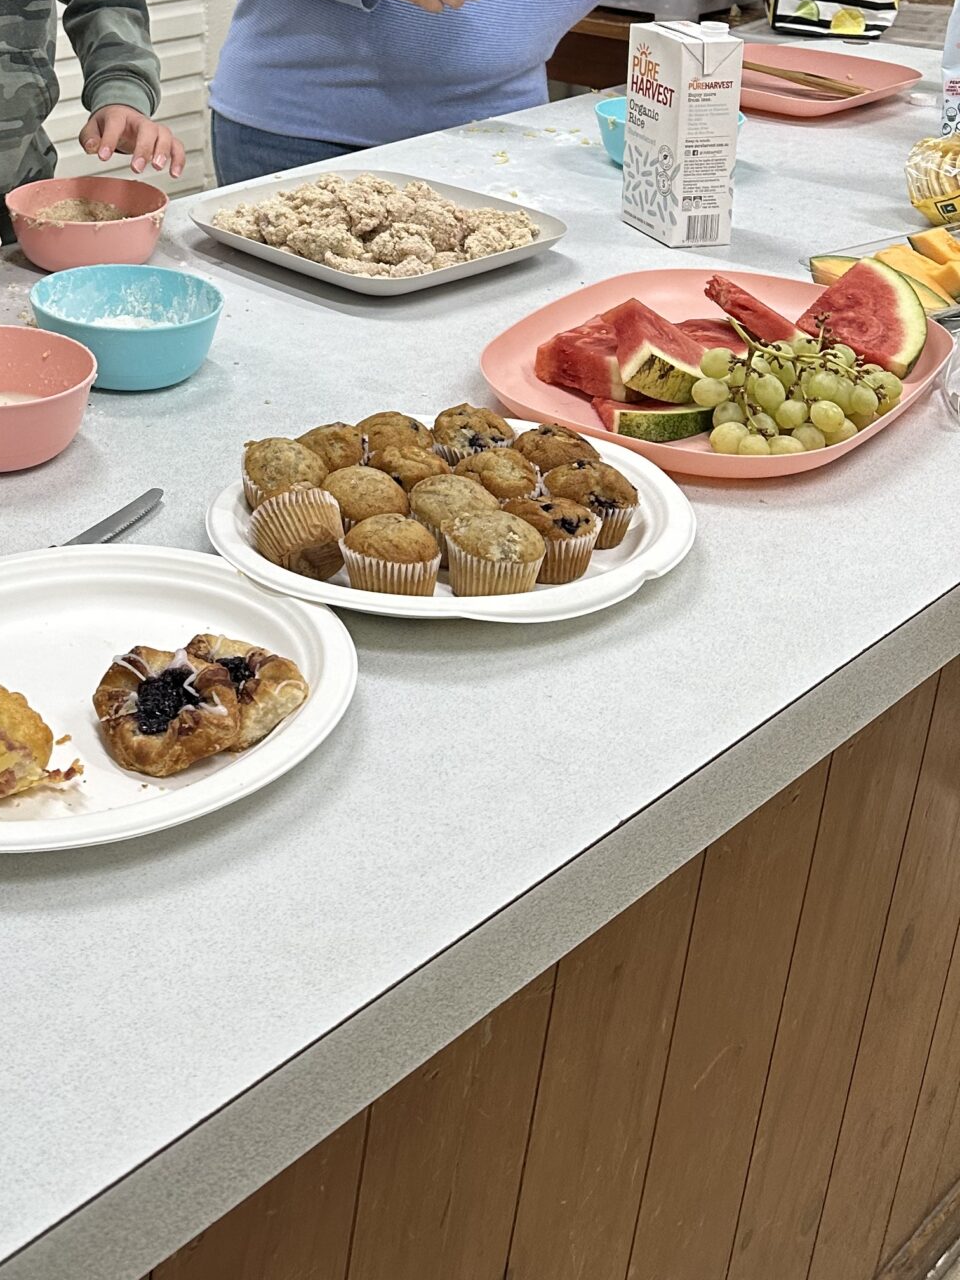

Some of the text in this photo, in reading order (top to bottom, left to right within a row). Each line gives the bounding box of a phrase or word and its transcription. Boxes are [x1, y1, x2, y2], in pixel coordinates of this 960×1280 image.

[632, 54, 661, 82] PURE
[630, 73, 675, 109] HARVEST
[688, 80, 734, 90] PUREHARVEST
[628, 111, 646, 129] Rice
[629, 98, 660, 122] Organic
